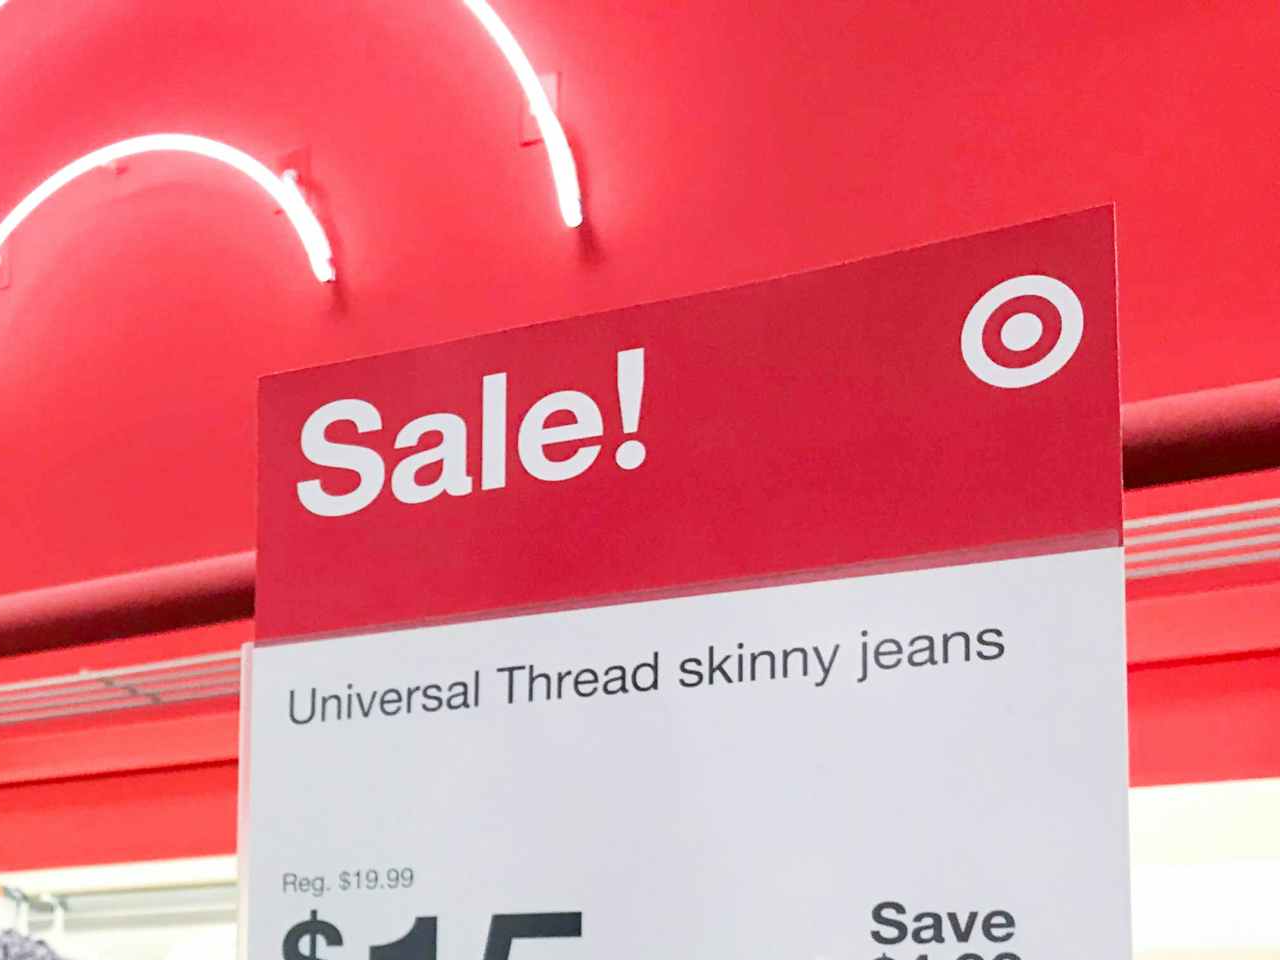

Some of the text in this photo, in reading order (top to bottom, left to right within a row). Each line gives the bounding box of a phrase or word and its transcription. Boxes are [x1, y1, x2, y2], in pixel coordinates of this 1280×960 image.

[296, 347, 648, 518] Sale!
[287, 626, 1006, 726] Universal Thread skinny jeans
[281, 867, 415, 897] Reg. $19.99
[869, 900, 1017, 946] Save
